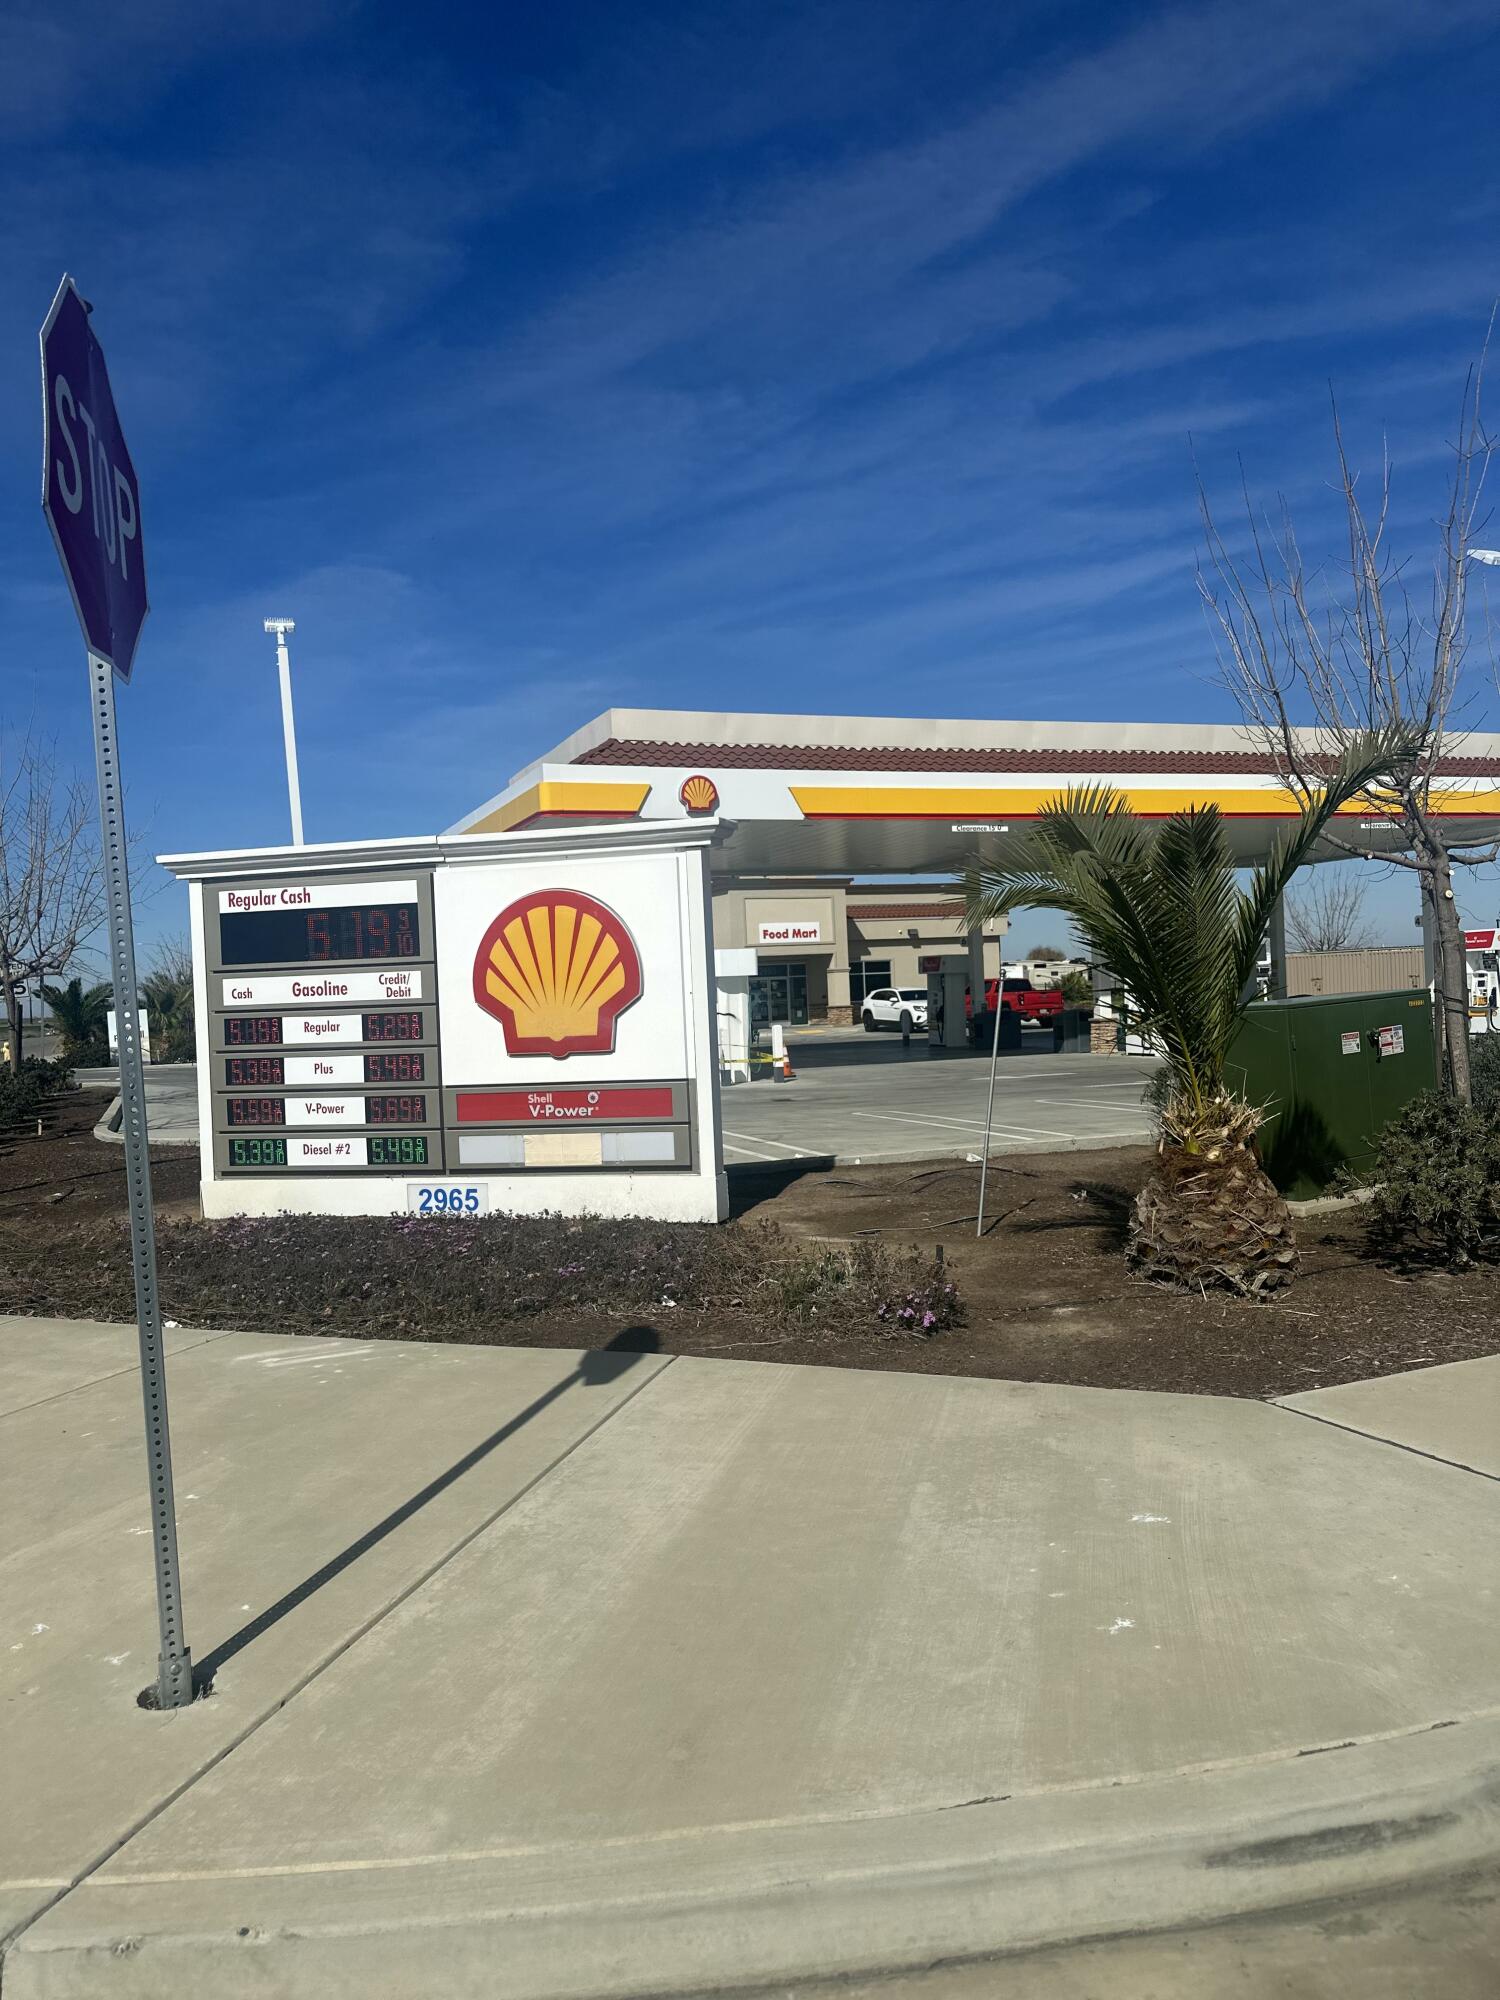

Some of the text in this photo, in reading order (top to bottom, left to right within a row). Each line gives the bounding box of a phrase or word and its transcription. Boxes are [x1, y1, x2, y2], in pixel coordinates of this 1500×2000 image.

[55, 374, 137, 581] STOP
[956, 824, 988, 832] Clearance
[228, 887, 311, 911] Regular Cash
[763, 928, 817, 940] Food Mart
[378, 972, 411, 985] Credit/
[231, 987, 253, 1000] Cash
[292, 980, 348, 997] Gasoline
[386, 986, 411, 998] Debit
[303, 1020, 341, 1036] Regular
[314, 1062, 334, 1075] Plus
[527, 1093, 553, 1103] Shell
[305, 1102, 345, 1115] V-Power
[302, 1142, 351, 1156] Diesel #2
[418, 1188, 479, 1213] 2965
